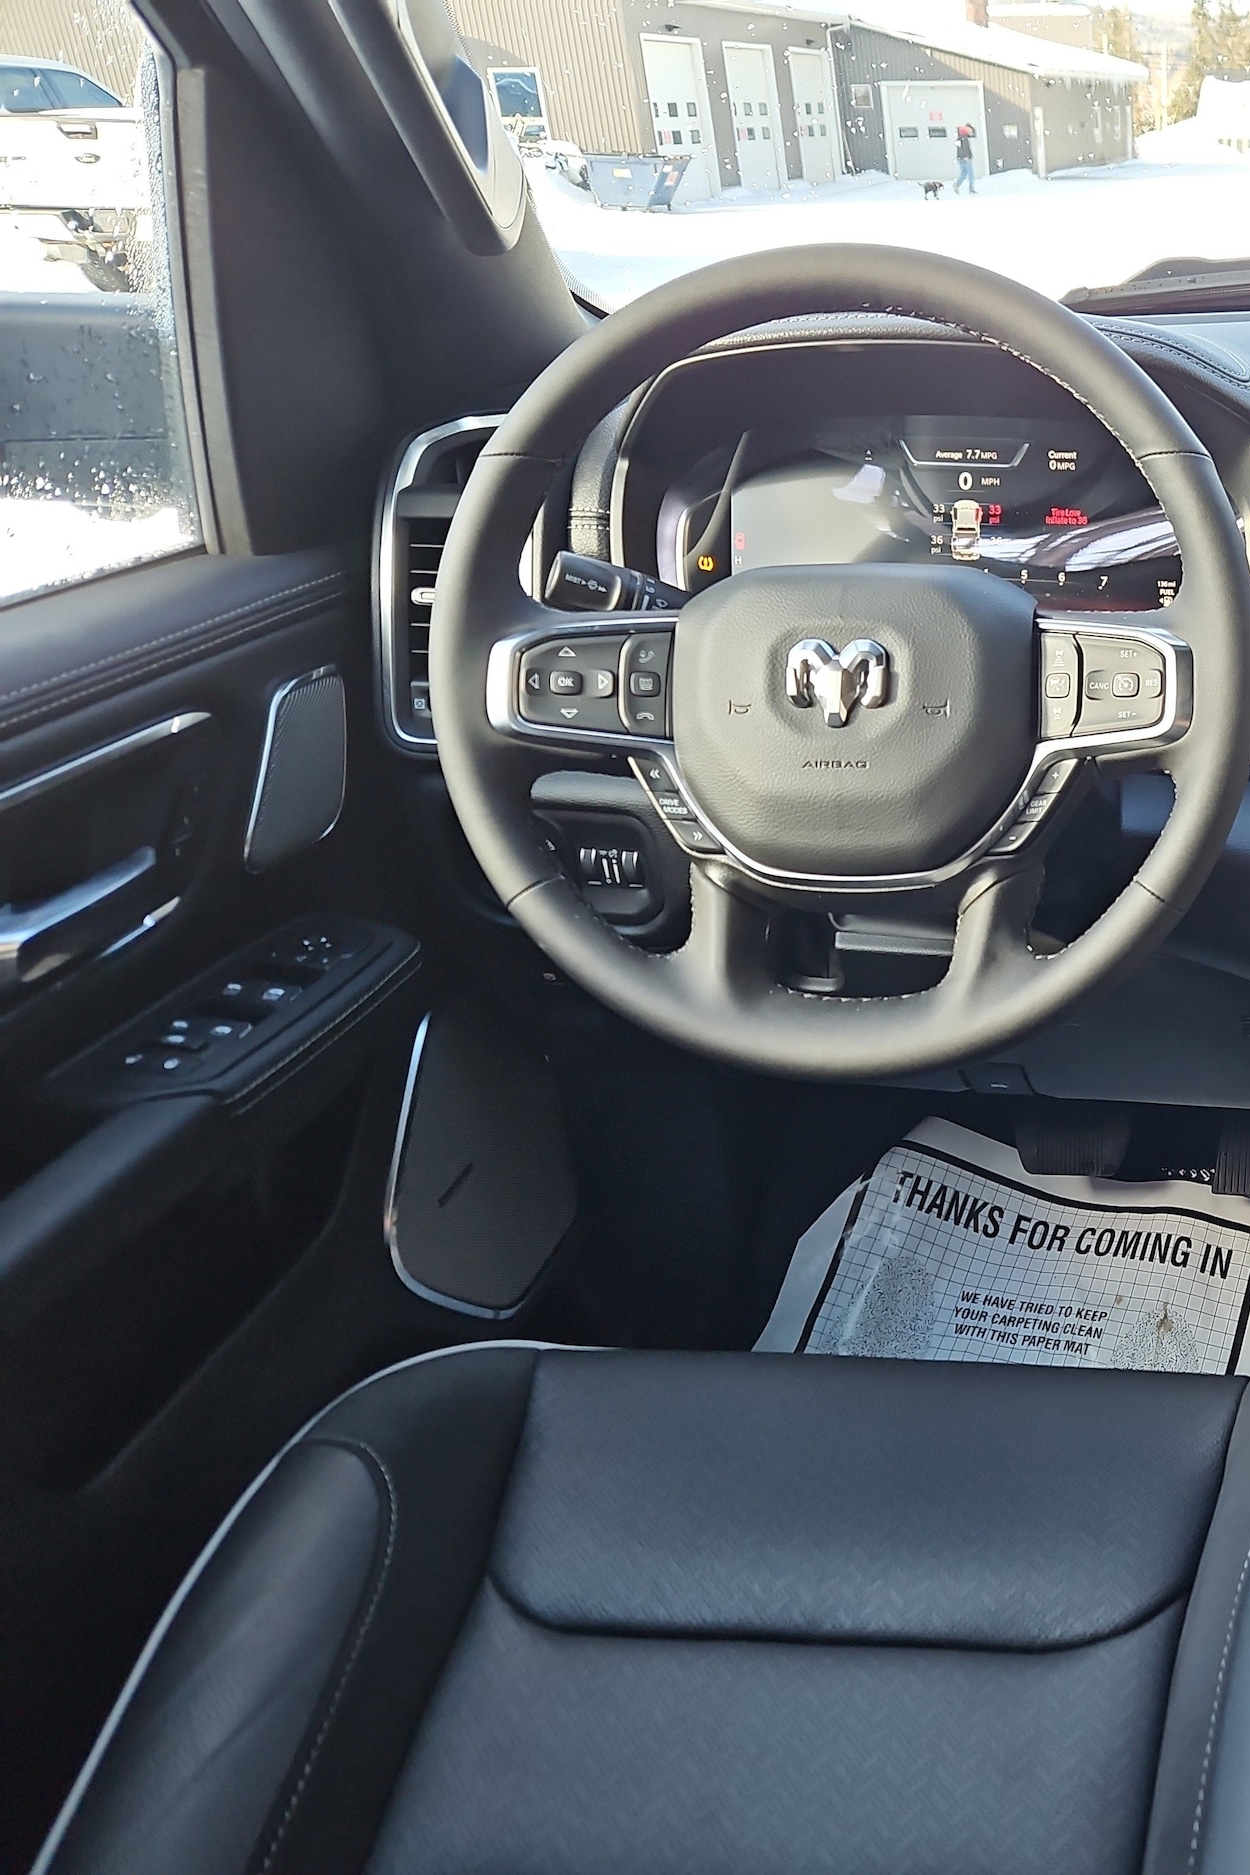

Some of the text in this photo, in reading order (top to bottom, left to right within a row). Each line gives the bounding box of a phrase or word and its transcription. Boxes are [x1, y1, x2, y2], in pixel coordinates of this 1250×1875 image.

[935, 450, 963, 461] Average
[1047, 450, 1078, 460] Current
[958, 471, 1000, 491] 0 MPH
[932, 504, 945, 514] 33
[988, 504, 1002, 514] 33
[933, 515, 944, 524] psi
[988, 516, 1001, 525] psi
[930, 535, 943, 545] 36
[930, 546, 942, 555] psi
[734, 556, 742, 565] H
[1020, 569, 1029, 580] 5
[1057, 571, 1066, 582] 6
[1100, 575, 1109, 587] 7
[1159, 588, 1175, 597] FUEL
[557, 676, 575, 687] OK
[1089, 682, 1109, 690] CANC
[1145, 679, 1158, 687] RES
[802, 760, 870, 769] AIRBAG
[658, 797, 680, 806] DRIVE
[1025, 807, 1043, 815] LIMIT
[892, 1170, 1233, 1280] THANKS FOR COMING IN
[961, 1290, 1108, 1322] WE HAVE TRIED TO KEEP
[954, 1306, 1104, 1340] YOUR CARPETING CLEAN
[954, 1323, 1091, 1356] WITH THIS PAPER MAT
